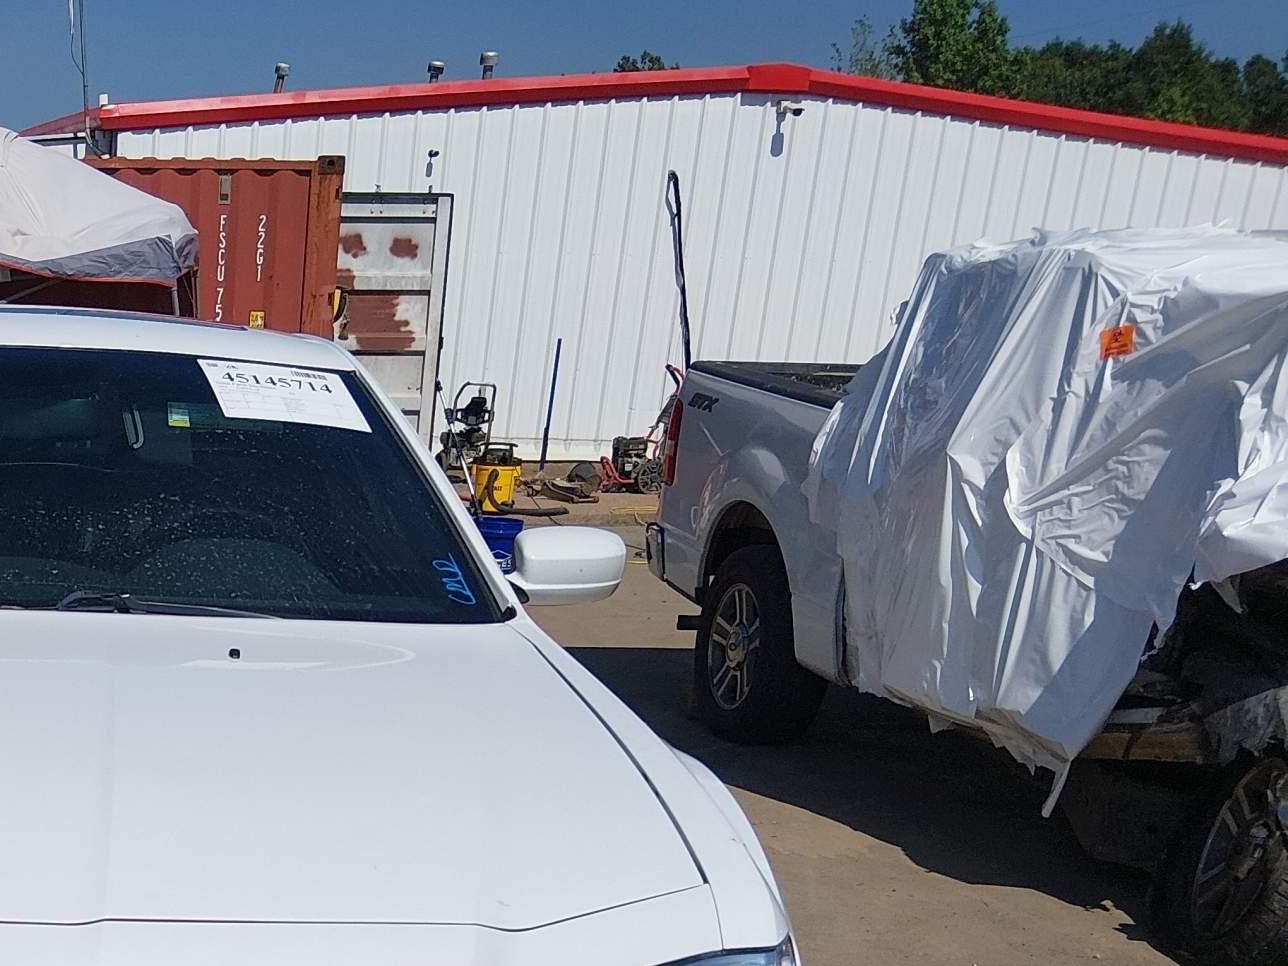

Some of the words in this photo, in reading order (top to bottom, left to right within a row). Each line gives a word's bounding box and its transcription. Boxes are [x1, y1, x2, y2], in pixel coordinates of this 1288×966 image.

[217, 214, 228, 282] FSCU
[256, 214, 267, 282] 22G1
[222, 371, 333, 394] 45145714
